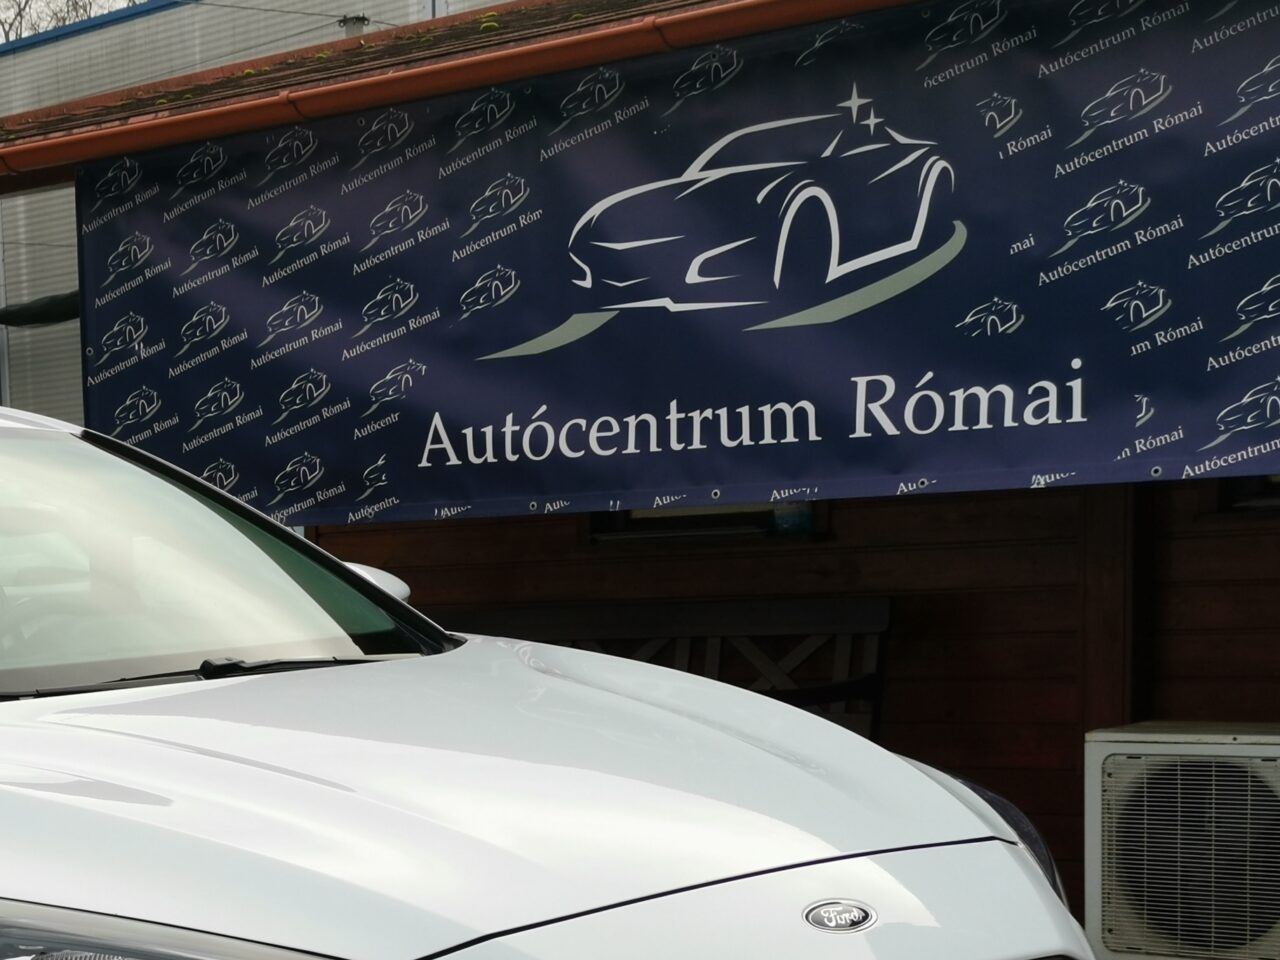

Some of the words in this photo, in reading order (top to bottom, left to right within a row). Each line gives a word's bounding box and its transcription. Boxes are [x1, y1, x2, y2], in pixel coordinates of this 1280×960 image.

[991, 25, 1038, 57] Római
[1037, 26, 1137, 79] Autócentrum
[1140, 2, 1191, 31] Római
[438, 137, 503, 180] Autócentrum
[504, 115, 538, 142] Római
[539, 117, 613, 162] Autócentrum
[613, 95, 650, 124] Római
[1053, 127, 1149, 179] Autócentrum
[1152, 101, 1204, 134] Római
[247, 172, 308, 210] Autócentrum
[308, 151, 340, 177] Római
[340, 155, 403, 196] Autócentrum
[404, 134, 437, 160] Római
[163, 187, 216, 224] Autócentrum
[217, 168, 248, 192] Római
[261, 248, 319, 288] Autócentrum
[319, 231, 351, 257] Római
[352, 236, 415, 276] Autócentrum
[416, 217, 451, 243] Római
[451, 221, 518, 263] Autócentrum
[1038, 239, 1132, 286] Autócentrum
[1134, 214, 1185, 245] Római
[94, 272, 144, 309] Autócentrum
[144, 257, 172, 280] Római
[171, 263, 230, 299] Autócentrum
[231, 245, 260, 269] Római
[168, 344, 220, 379] Autócentrum
[220, 327, 249, 351] Római
[250, 335, 309, 370] Autócentrum
[310, 317, 343, 342] Római
[341, 323, 407, 361] Autócentrum
[408, 306, 441, 331] Római
[1153, 316, 1205, 347] Római
[87, 352, 139, 387] Autócentrum
[153, 412, 180, 435] Római
[182, 422, 234, 454] Autócentrum
[235, 405, 264, 428] Római
[265, 412, 321, 447] Autócentrum
[321, 396, 352, 420] Római
[417, 398, 822, 467] Autócentrum
[849, 357, 1089, 439] Római
[1134, 425, 1185, 454] Római
[820, 906, 862, 927] Ford
